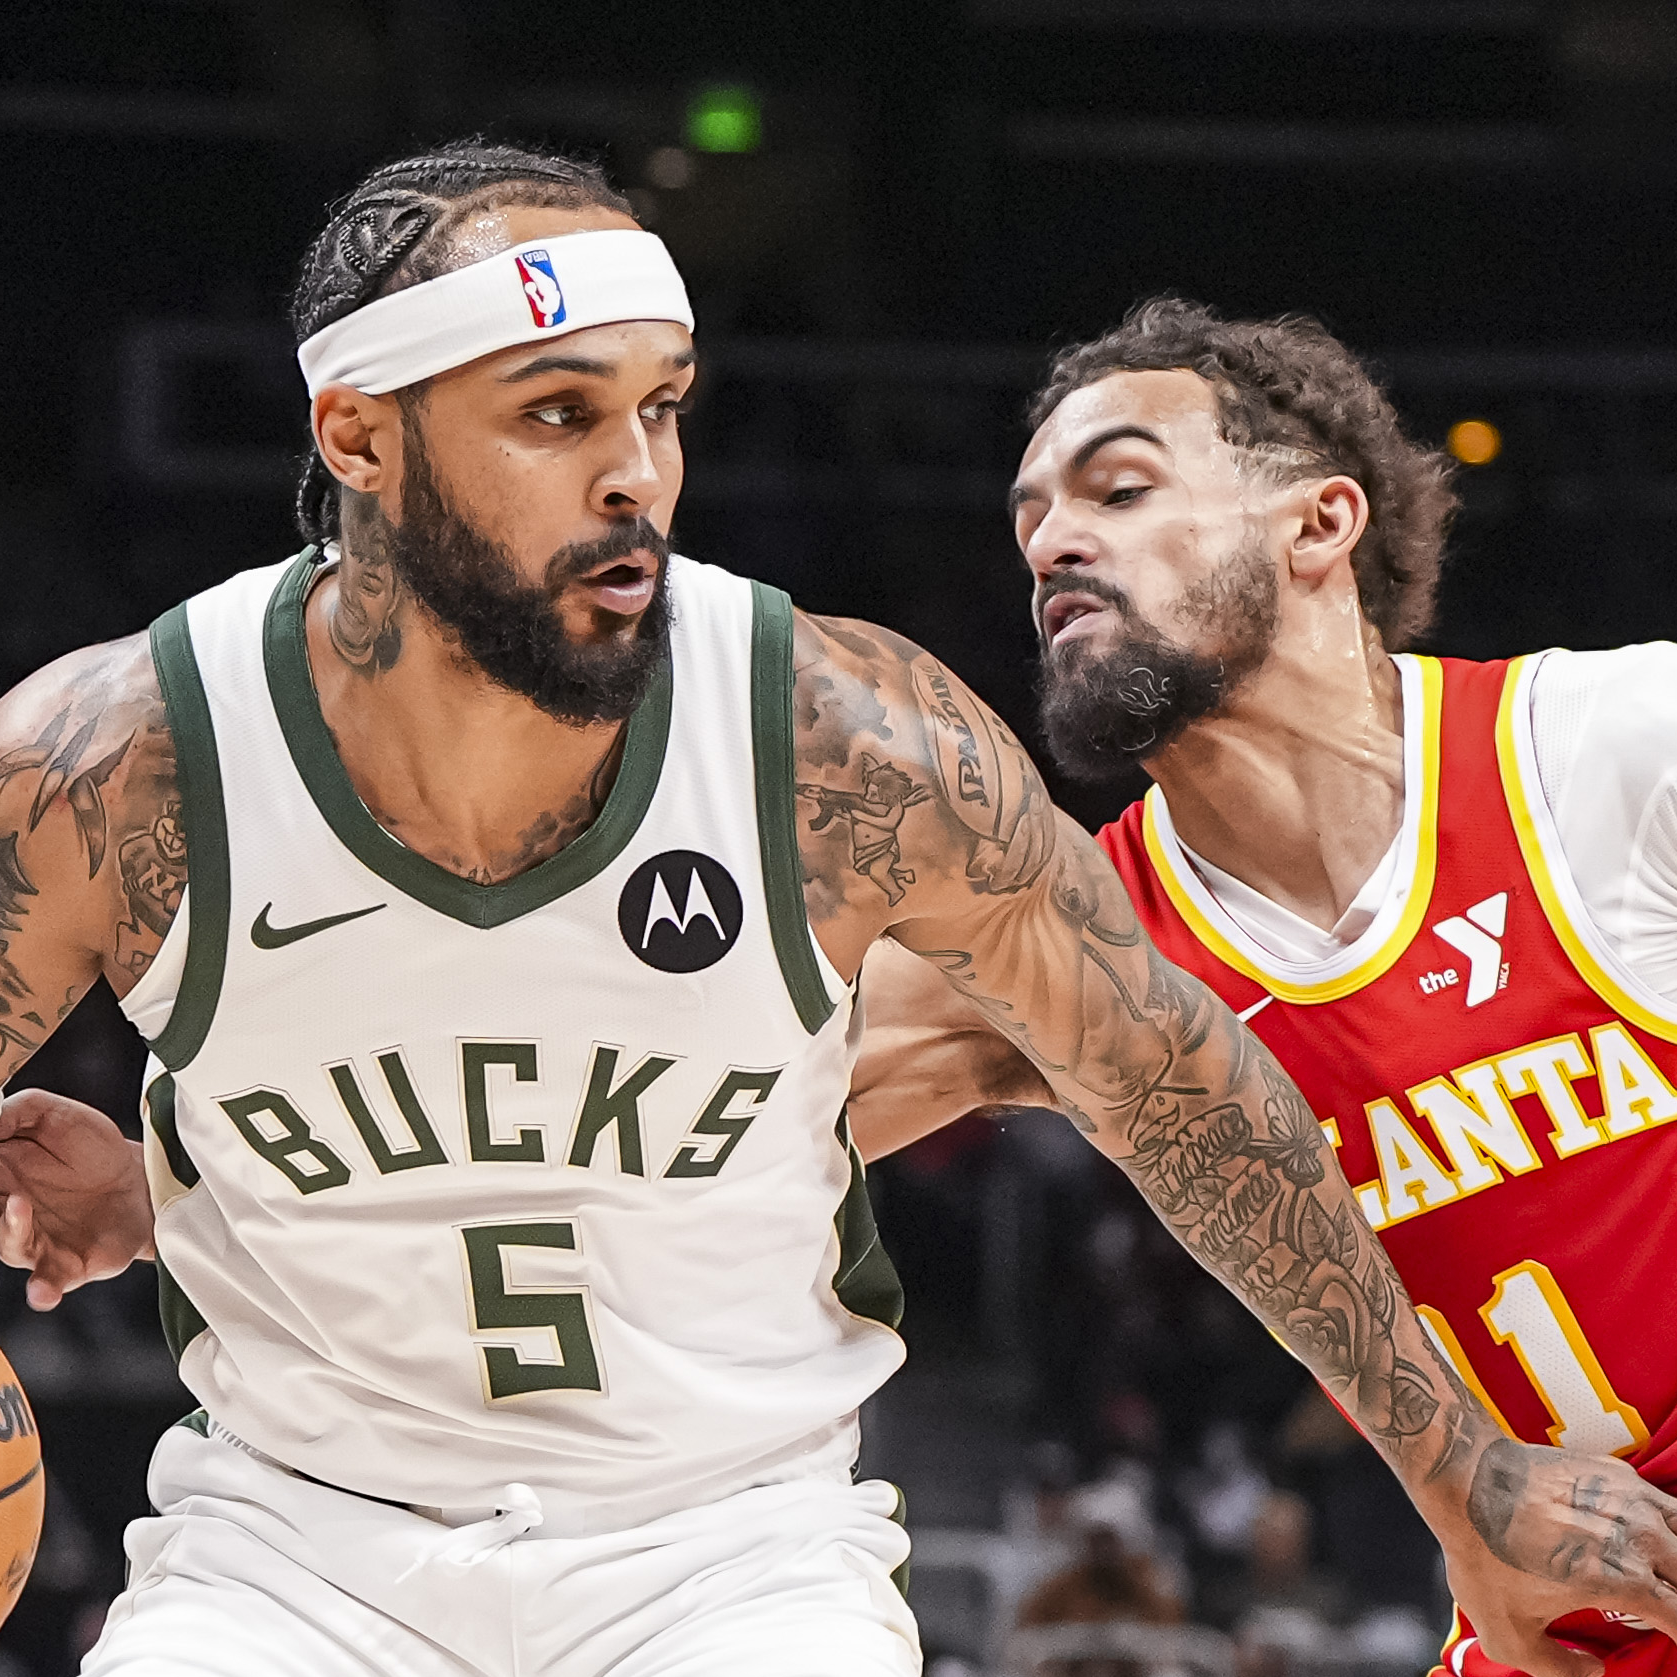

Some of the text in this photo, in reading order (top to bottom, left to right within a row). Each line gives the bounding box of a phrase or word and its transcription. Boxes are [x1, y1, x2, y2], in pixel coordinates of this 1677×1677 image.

[1419, 968, 1459, 994] the
[1498, 962, 1510, 990] YMCA
[211, 1036, 789, 1197] BUCKS
[452, 1216, 609, 1403] 5
